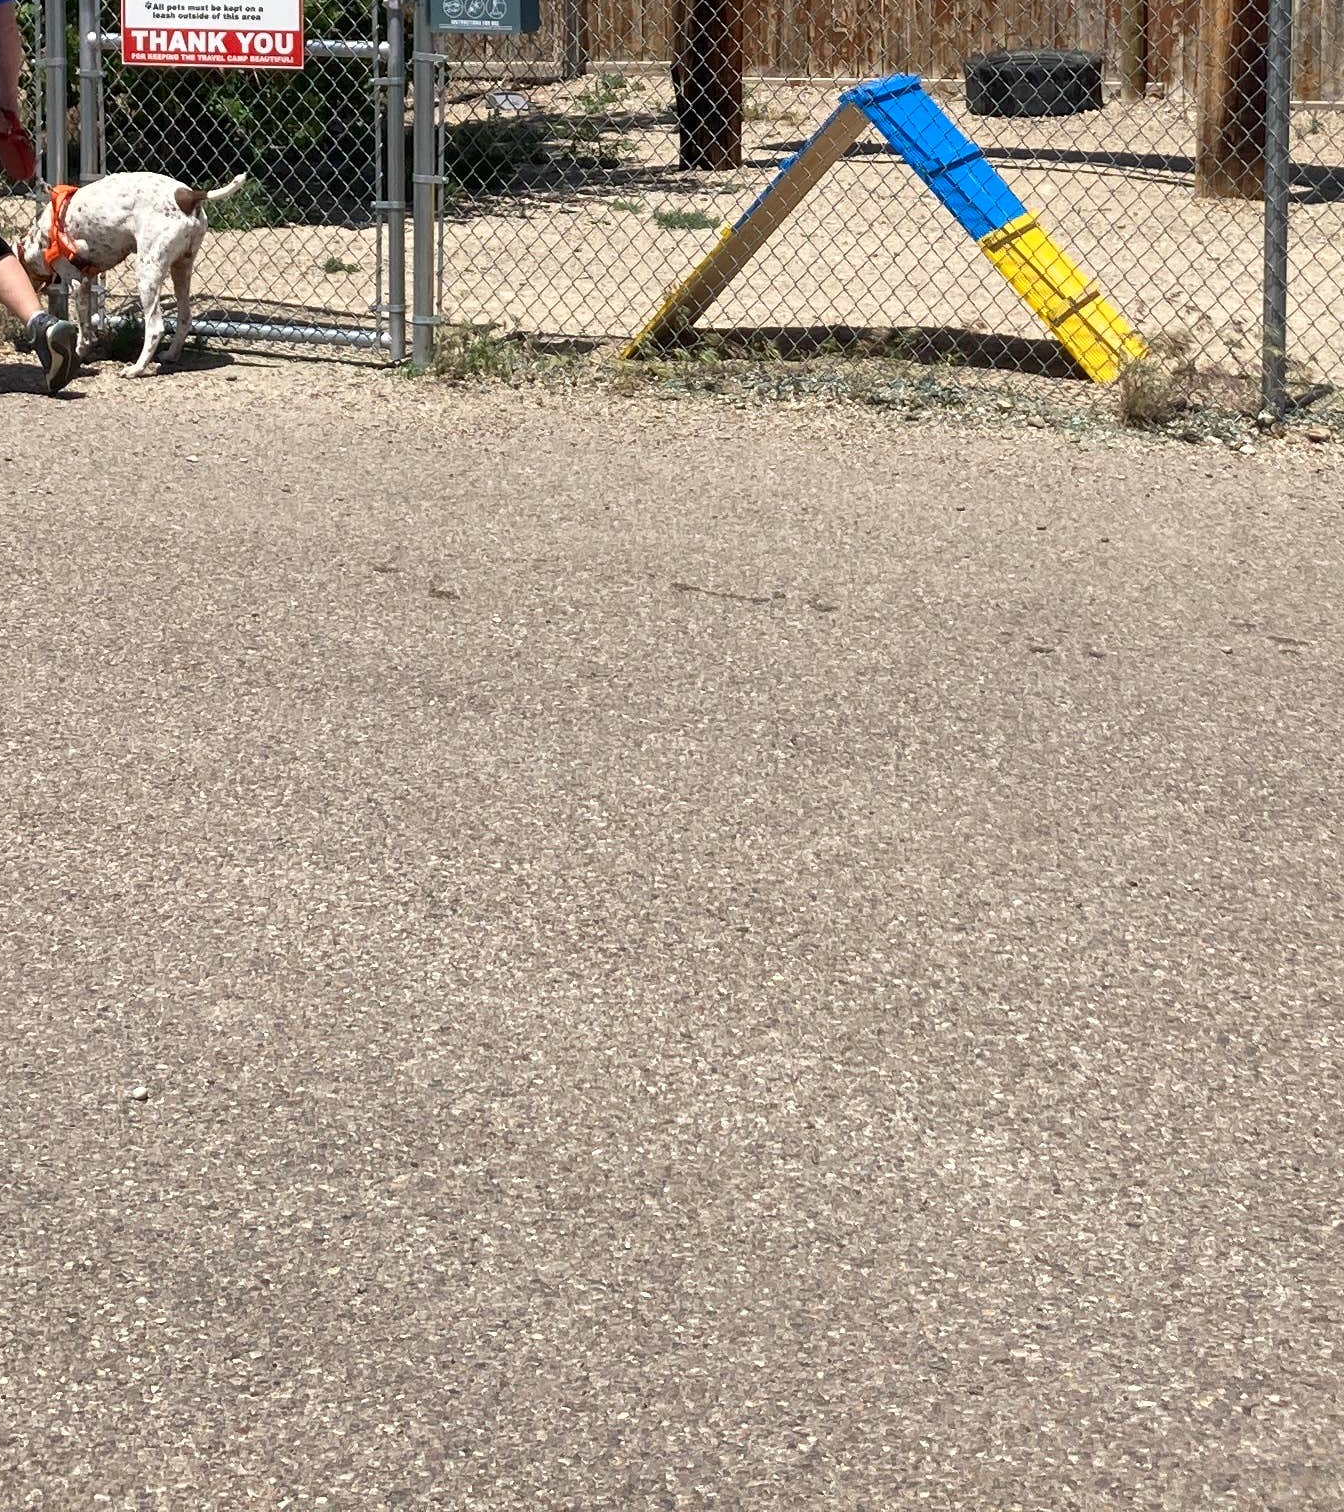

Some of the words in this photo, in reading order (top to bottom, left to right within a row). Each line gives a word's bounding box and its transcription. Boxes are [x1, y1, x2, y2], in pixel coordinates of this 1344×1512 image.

[167, 4, 185, 12] pets
[131, 30, 227, 52] THANK
[235, 32, 294, 54] YOU
[197, 54, 226, 62] TRAVEL
